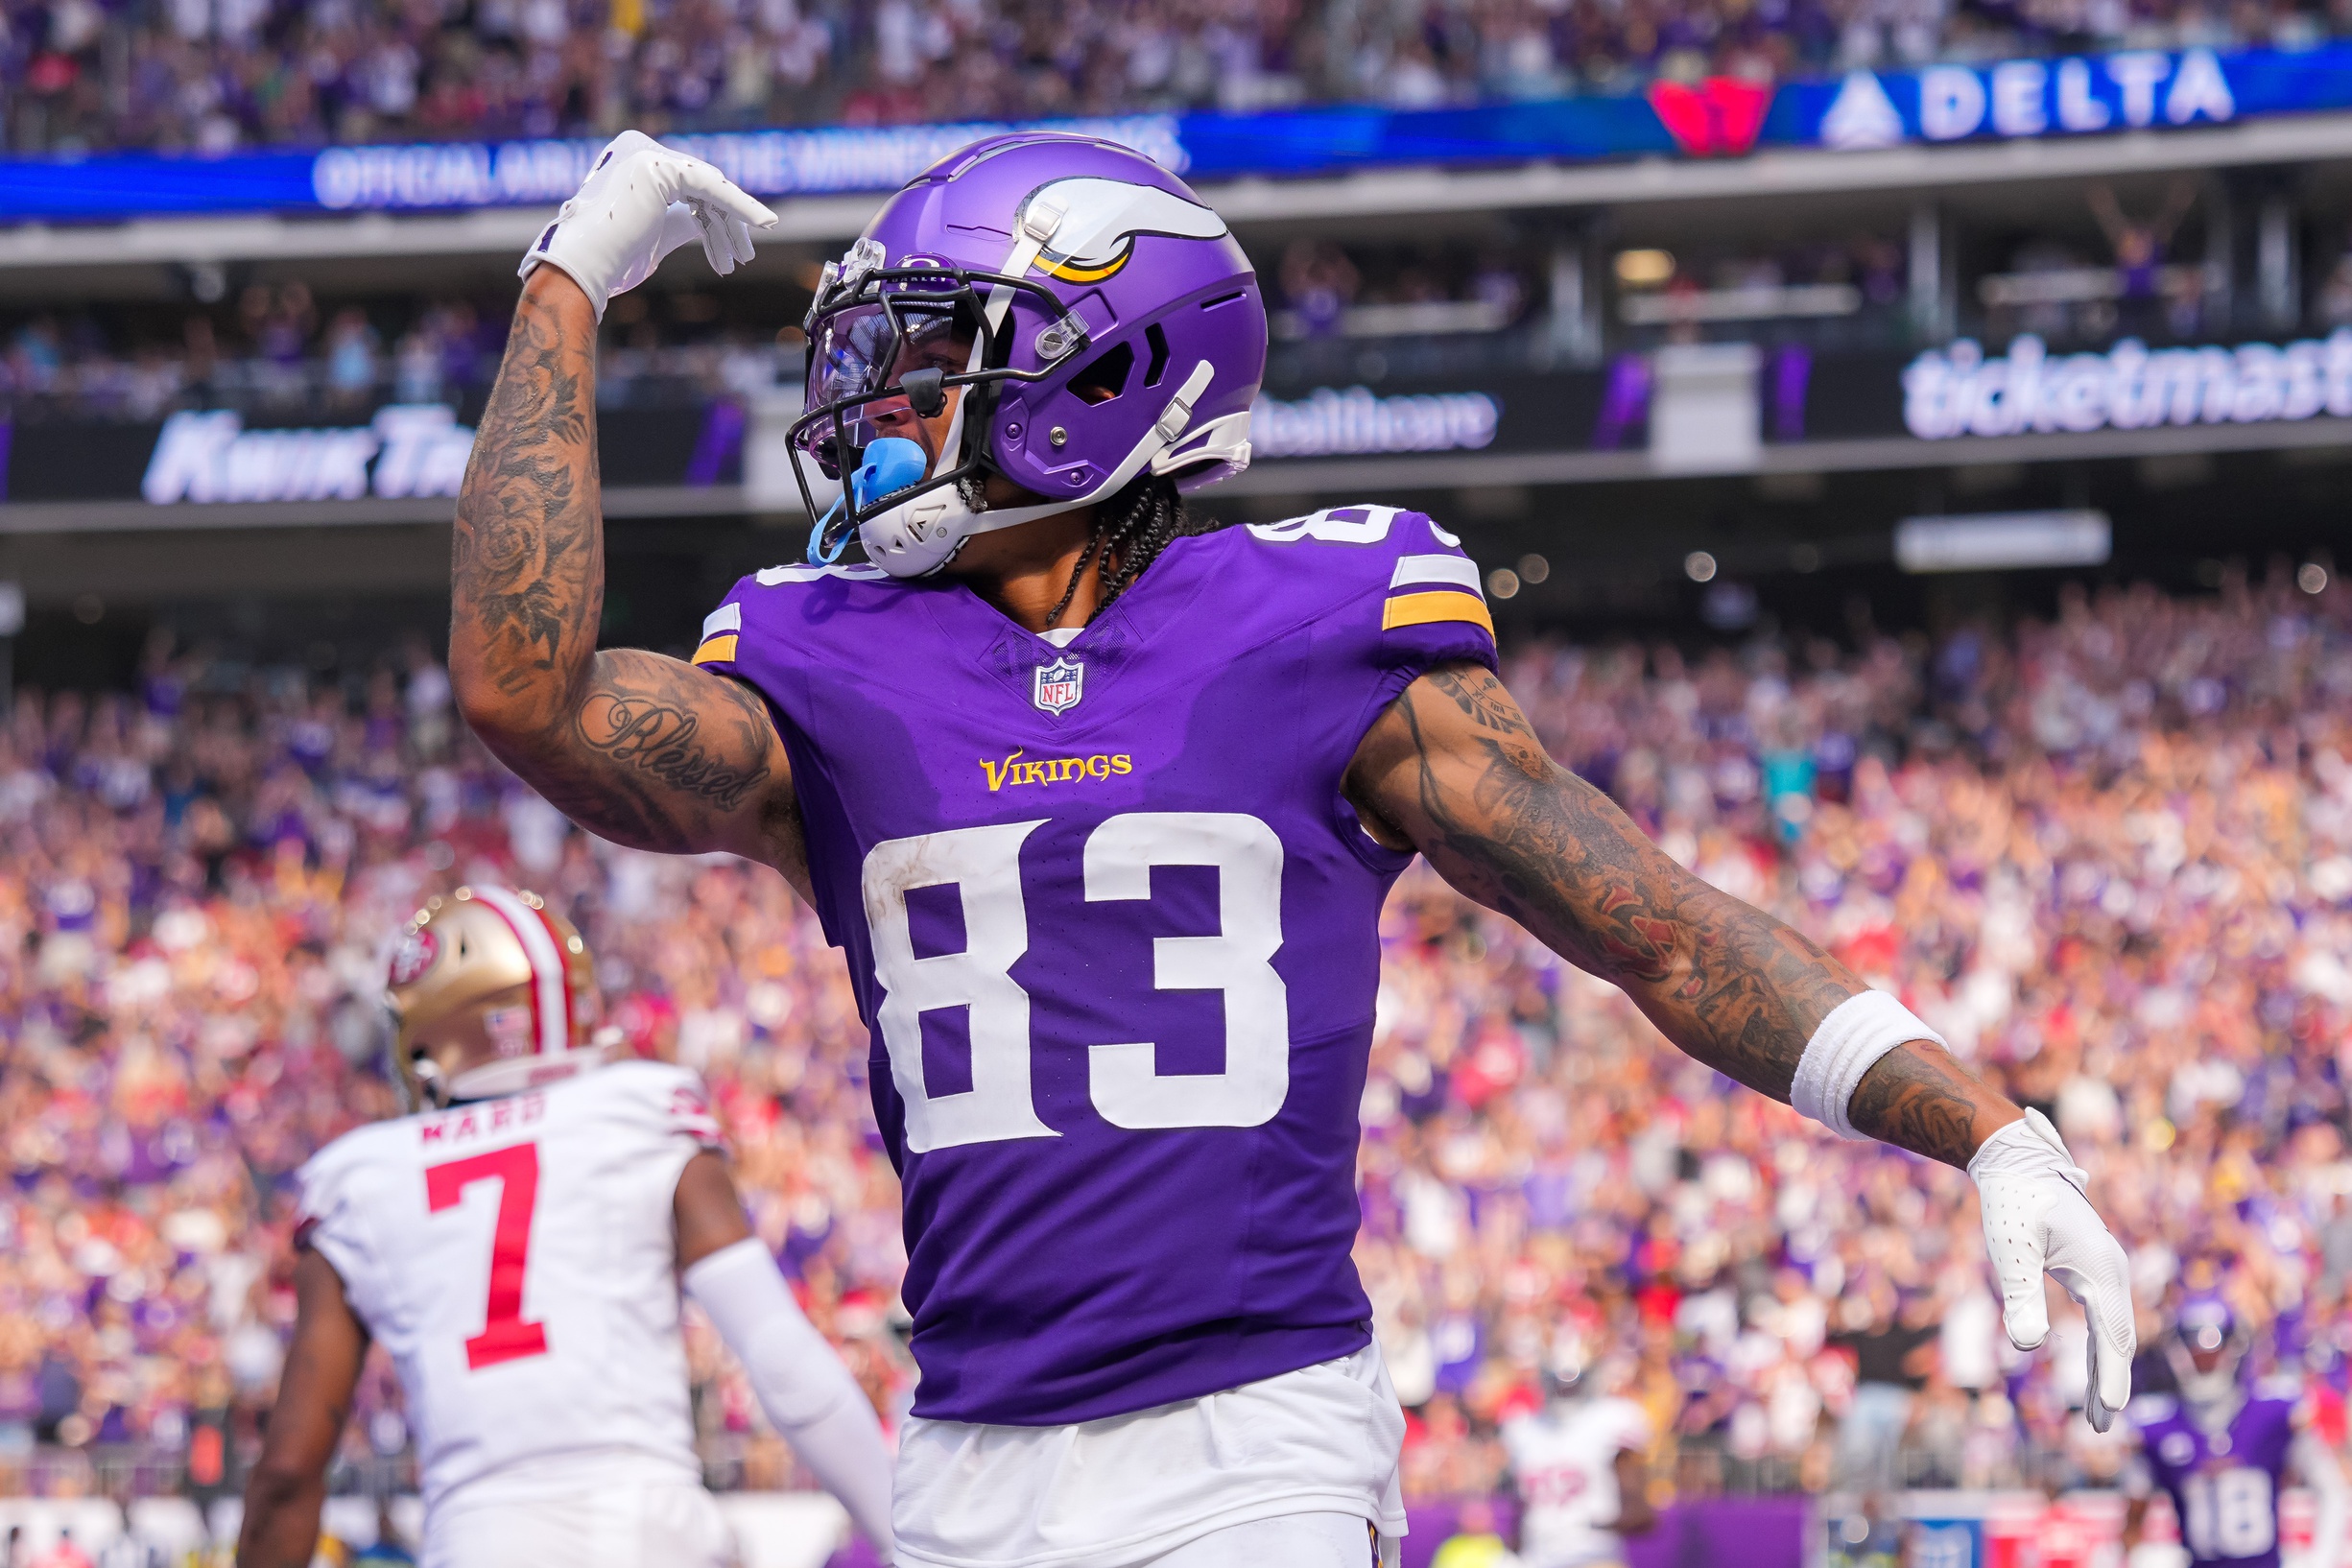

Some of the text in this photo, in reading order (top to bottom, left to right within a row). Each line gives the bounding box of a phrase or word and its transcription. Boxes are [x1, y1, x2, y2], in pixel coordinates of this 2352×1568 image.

[1919, 46, 2236, 141] DELTA
[1042, 682, 1074, 704] NFL
[579, 693, 771, 812] Blessed
[862, 812, 1290, 1153] 83
[425, 1141, 548, 1370] 7
[2181, 1466, 2275, 1561] 18
